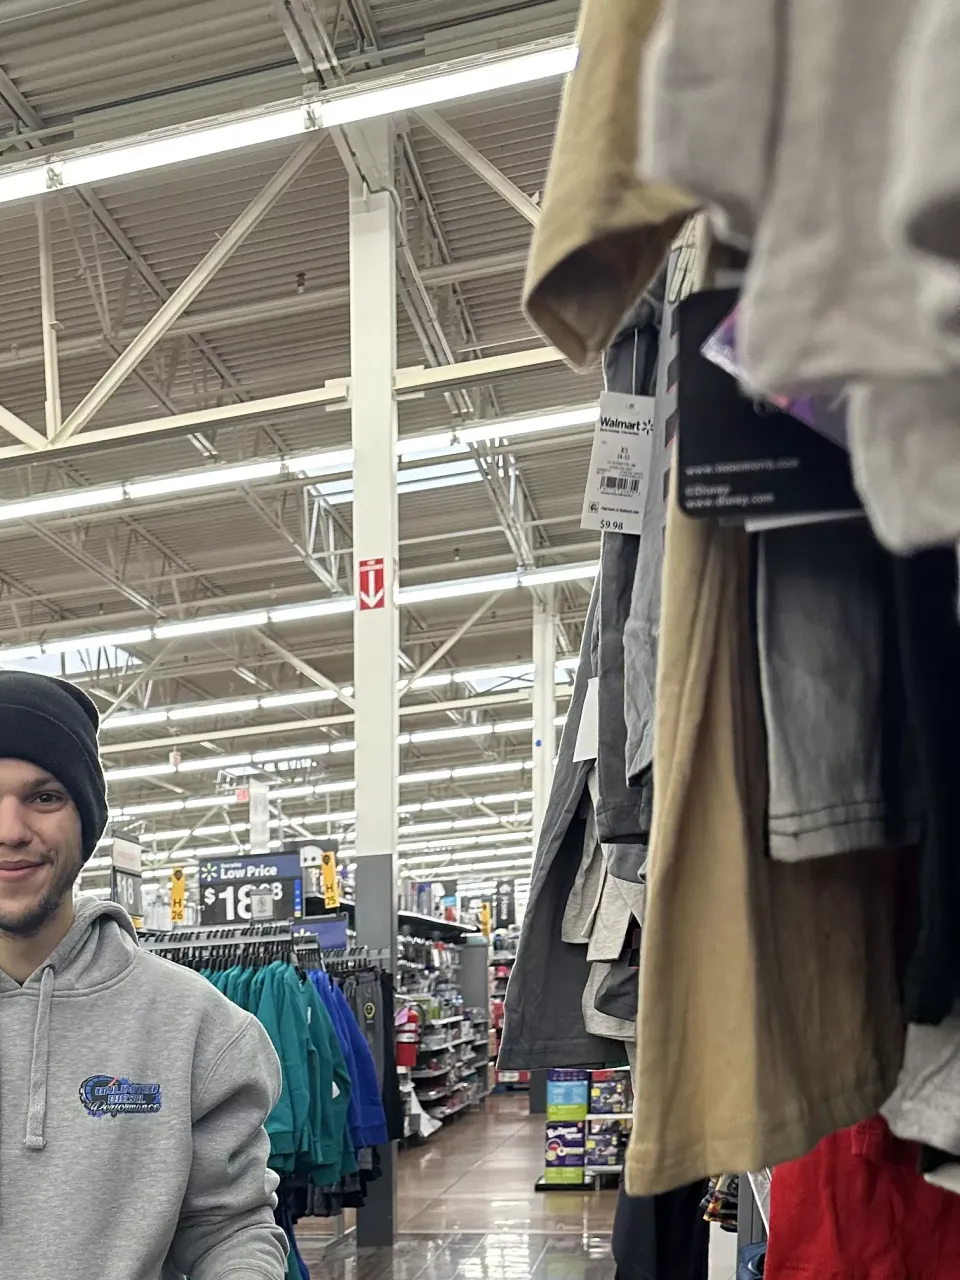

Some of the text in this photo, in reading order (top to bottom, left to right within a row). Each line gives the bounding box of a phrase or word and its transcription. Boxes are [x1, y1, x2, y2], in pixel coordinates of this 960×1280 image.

[600, 416, 640, 432] Walmart
[685, 494, 773, 508] www.disney.com
[600, 519, 624, 531] $9.98
[220, 864, 278, 880] Low Price
[173, 898, 182, 908] H
[171, 910, 184, 921] 26
[91, 1101, 160, 1115] Performance
